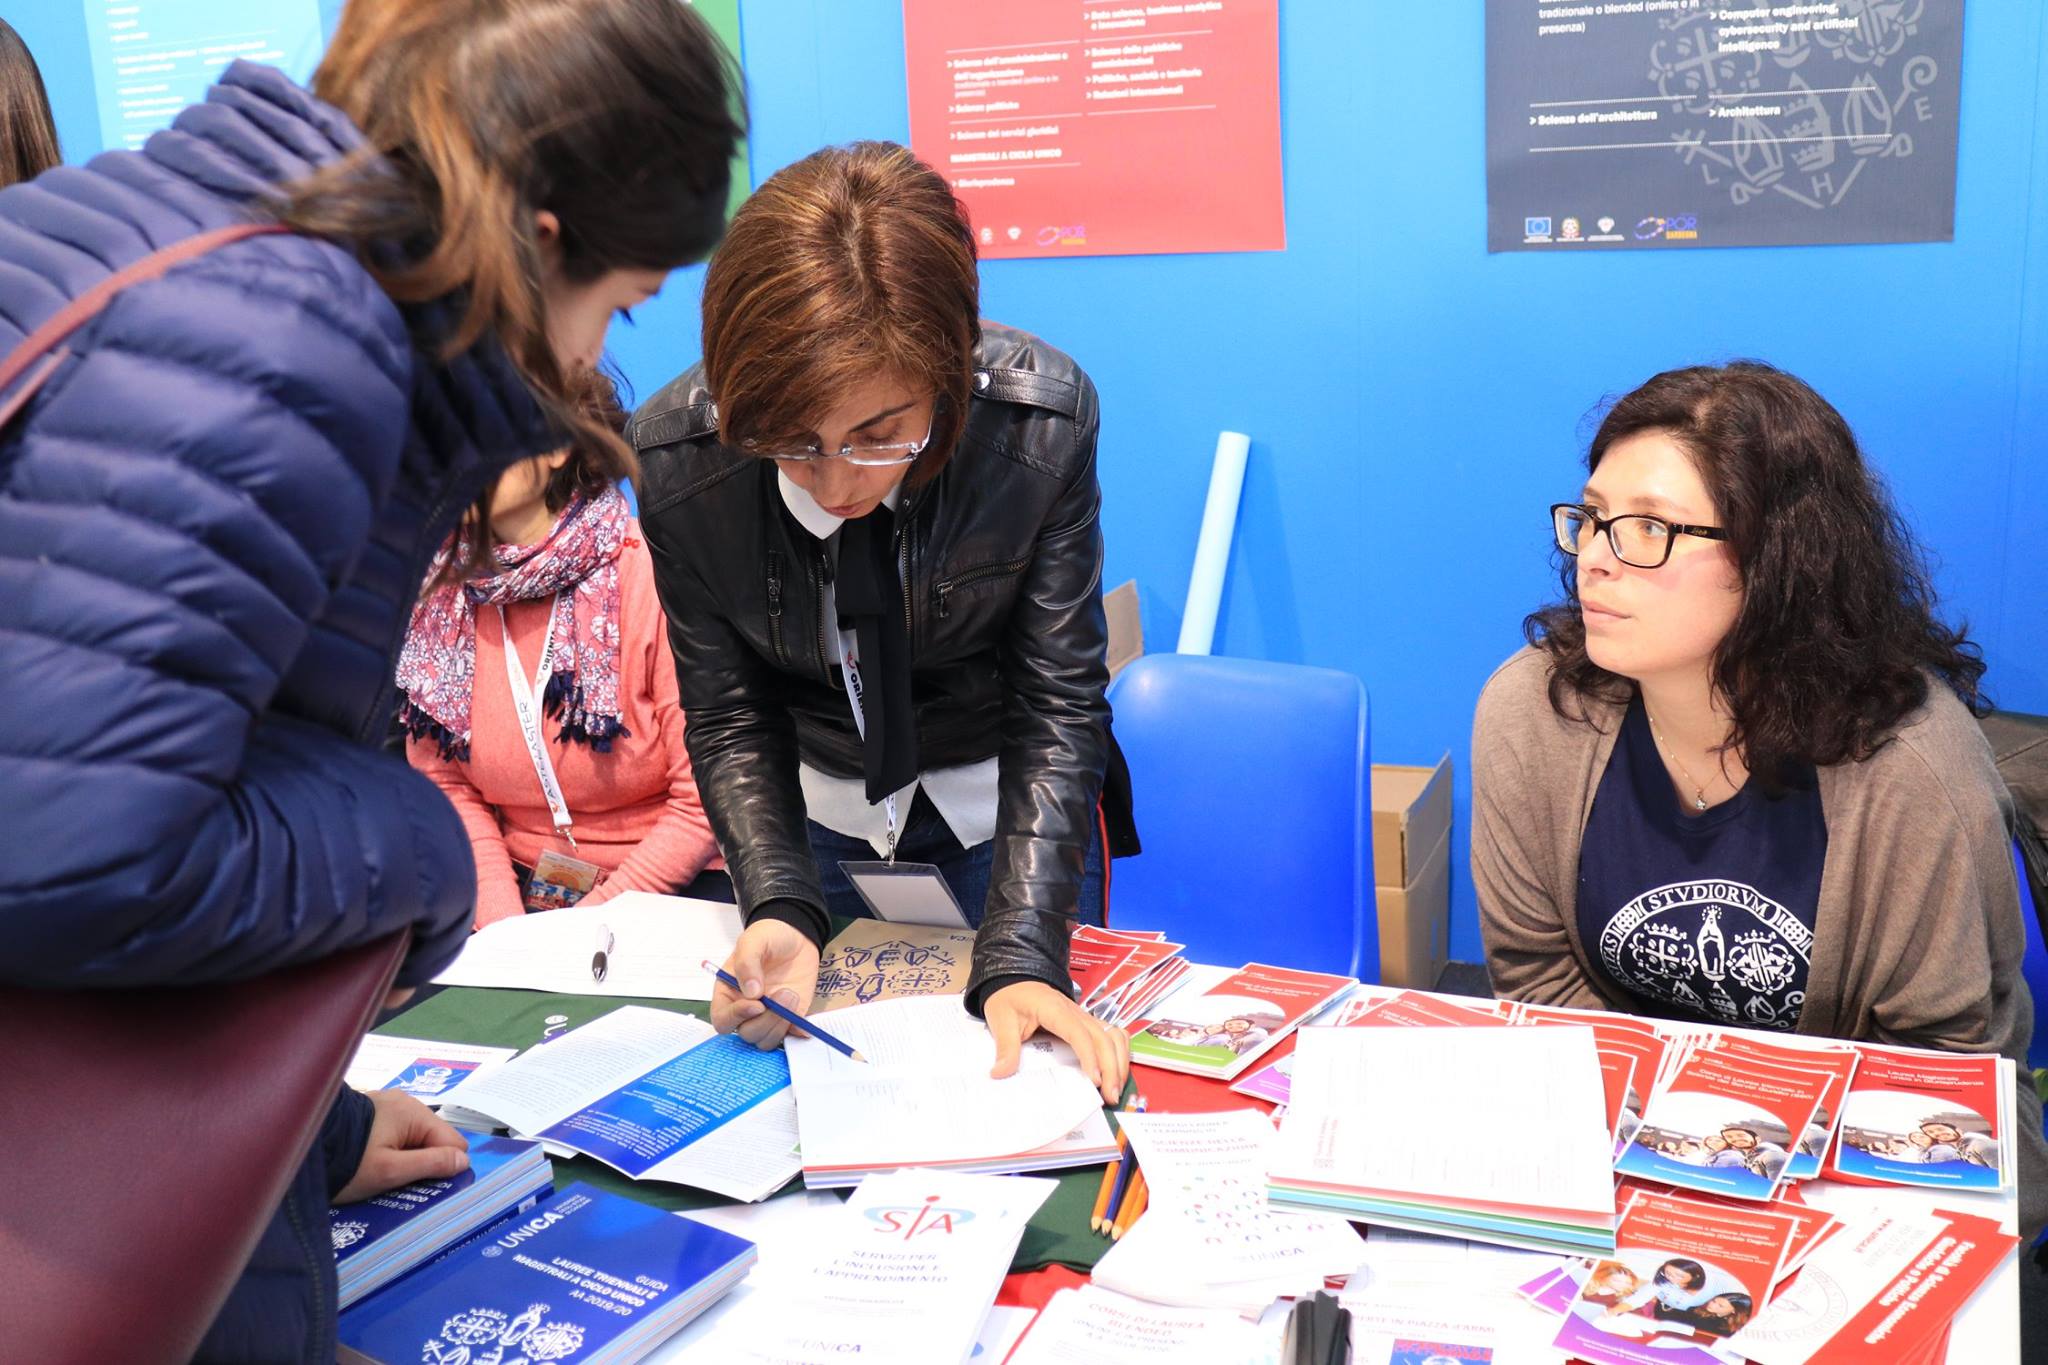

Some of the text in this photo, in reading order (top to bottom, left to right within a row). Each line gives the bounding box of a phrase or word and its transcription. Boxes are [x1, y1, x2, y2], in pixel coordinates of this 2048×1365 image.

[1539, 6, 1594, 18] tradizionale
[1604, 3, 1644, 14] blended
[1718, 8, 1770, 22] Computer
[1538, 22, 1586, 36] presenza)
[1718, 17, 1858, 38] cybersecurity and artificial
[1538, 110, 1658, 126] Scienze dell'architettura
[1718, 105, 1781, 118] Architettura
[1666, 216, 1697, 231] POR
[1648, 884, 1768, 919] STVDIORVM
[497, 1211, 564, 1248] UNICA
[908, 1253, 937, 1261] PER
[512, 1253, 646, 1308] MAGISTRALI A CICLO UNICO
[552, 1256, 659, 1300] LAUREE TRIENNALI E
[635, 1274, 668, 1292] GUIDA
[584, 1294, 632, 1316] 2019/20
